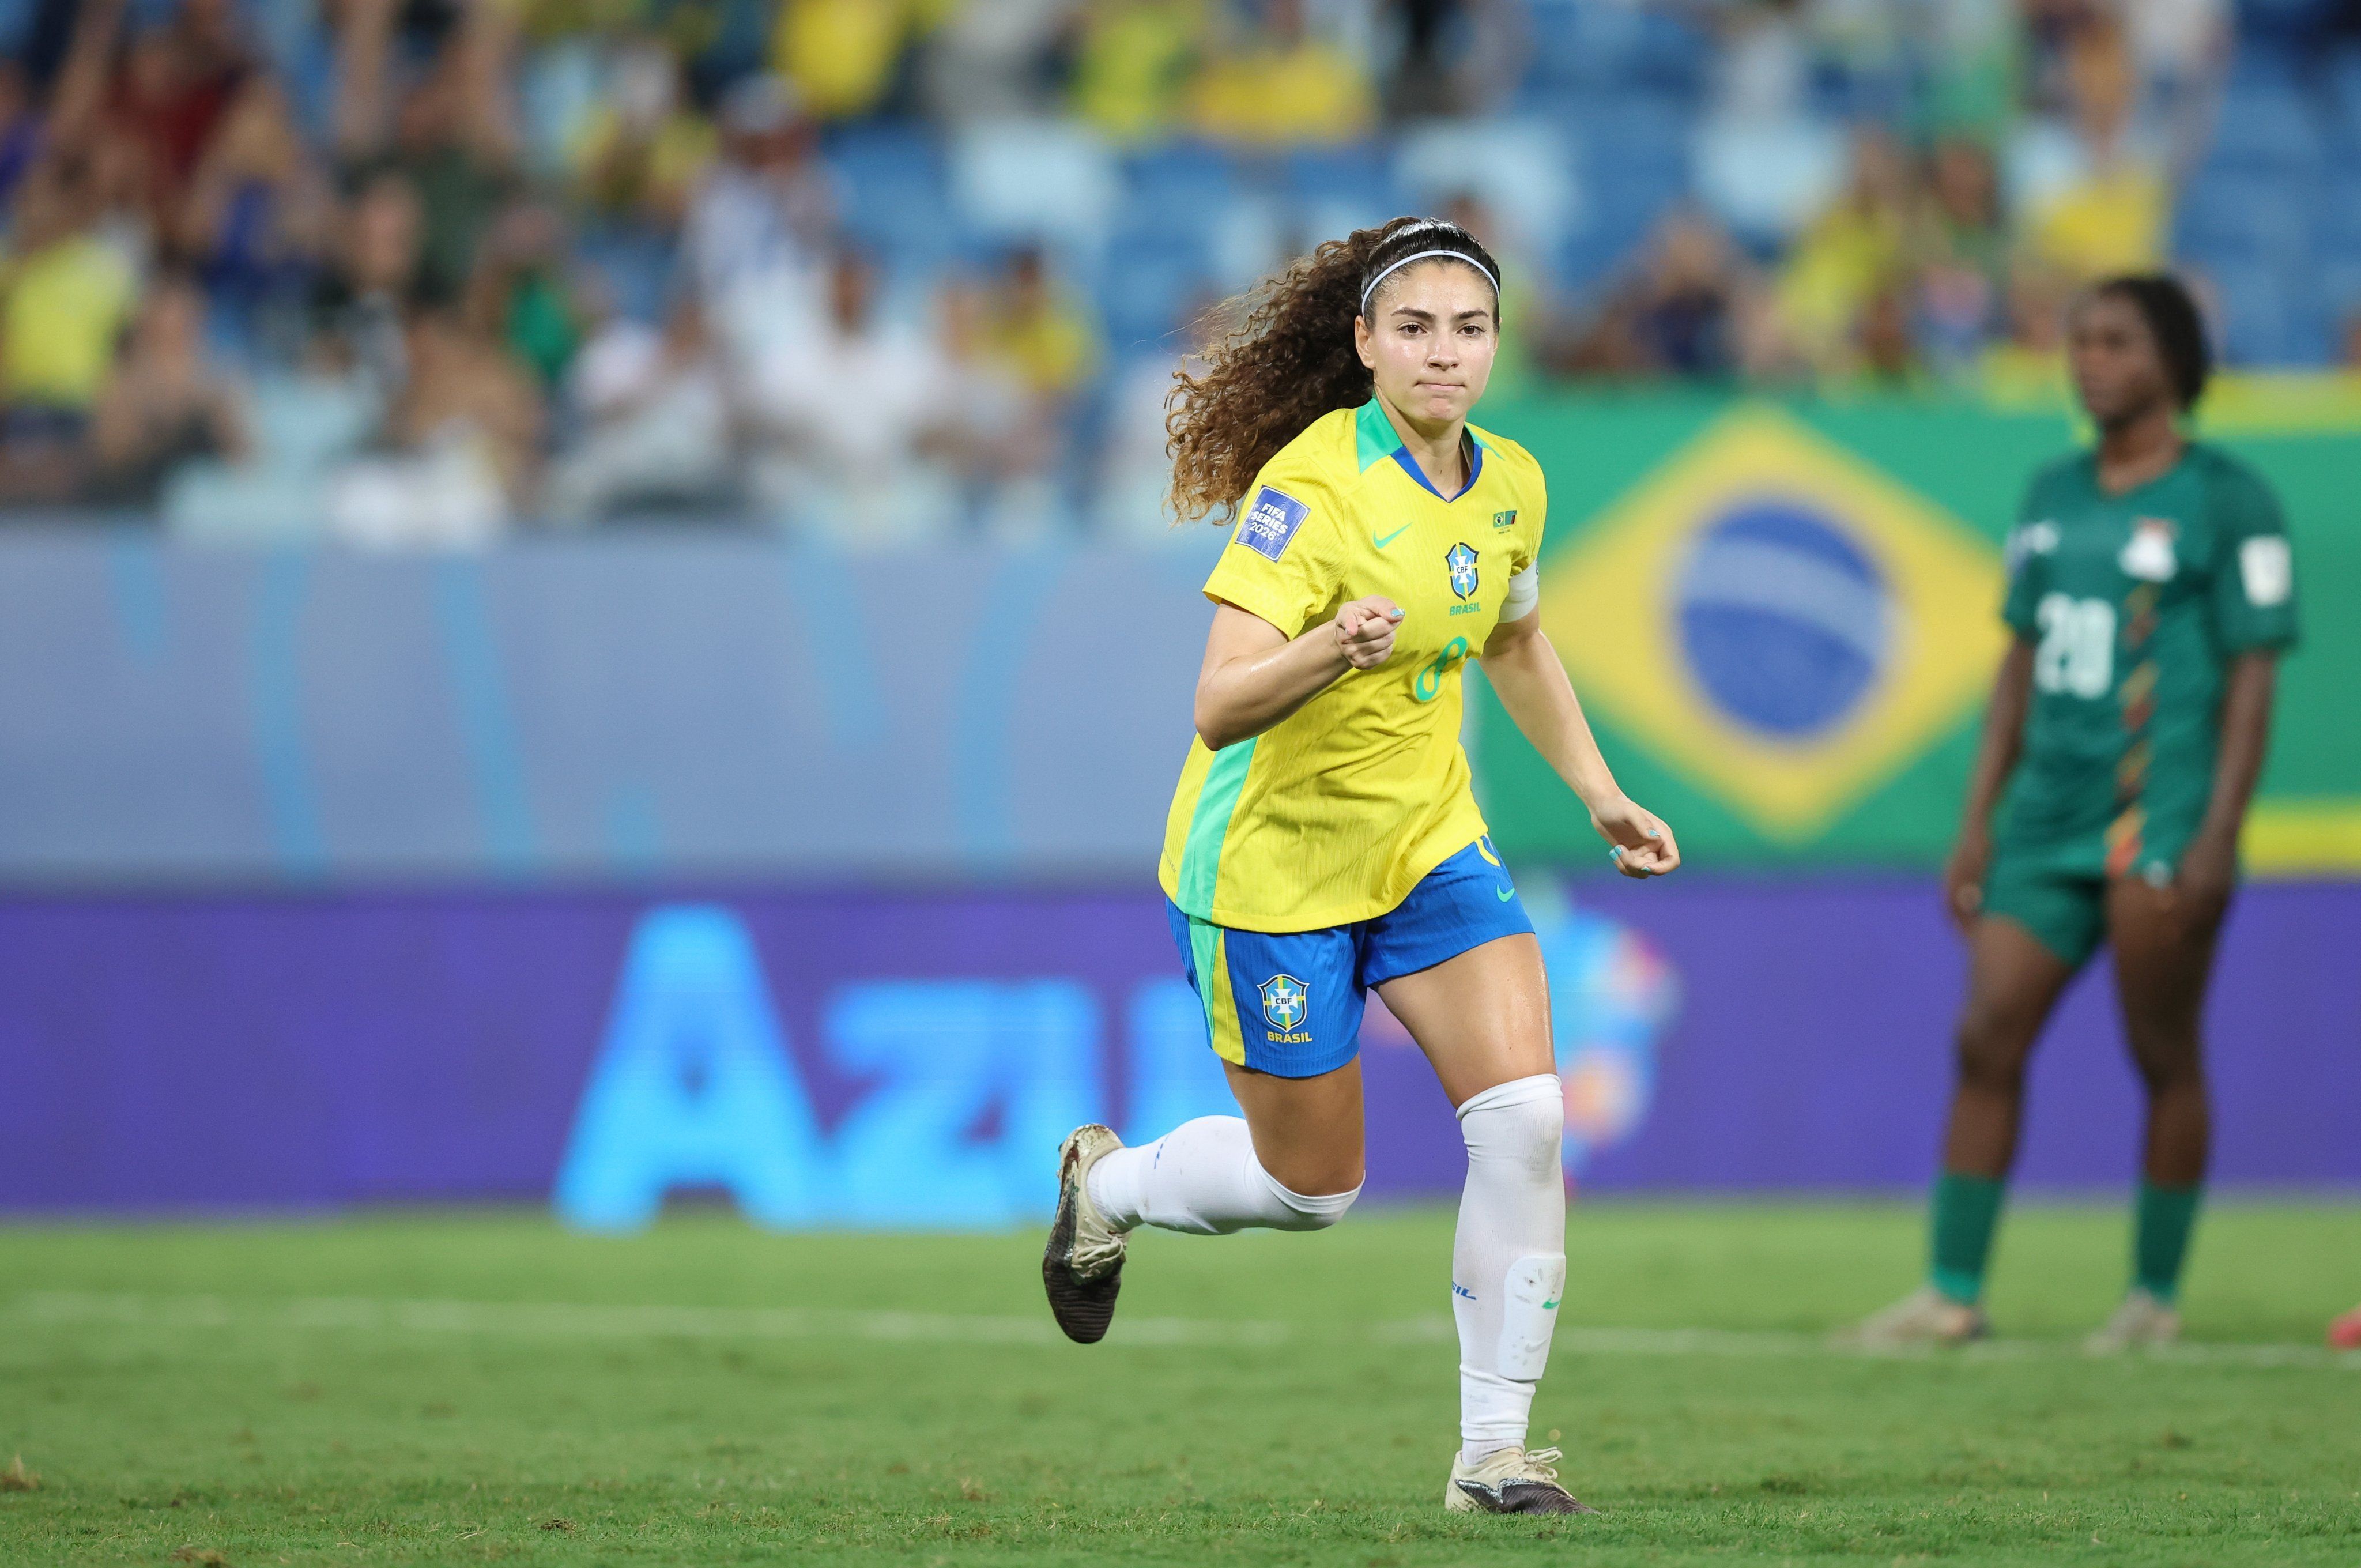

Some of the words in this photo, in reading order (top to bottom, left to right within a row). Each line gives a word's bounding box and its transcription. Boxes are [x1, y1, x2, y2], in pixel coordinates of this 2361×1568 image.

[1261, 503, 1286, 522] FIFA
[1249, 522, 1277, 540] 2026
[1251, 511, 1288, 534] SERIES
[1457, 566, 1468, 574] CBF
[1449, 602, 1481, 616] BRASIL
[1415, 636, 1468, 701] 8
[1267, 1031, 1312, 1043] BRASIL
[552, 903, 1242, 1231] Azu
